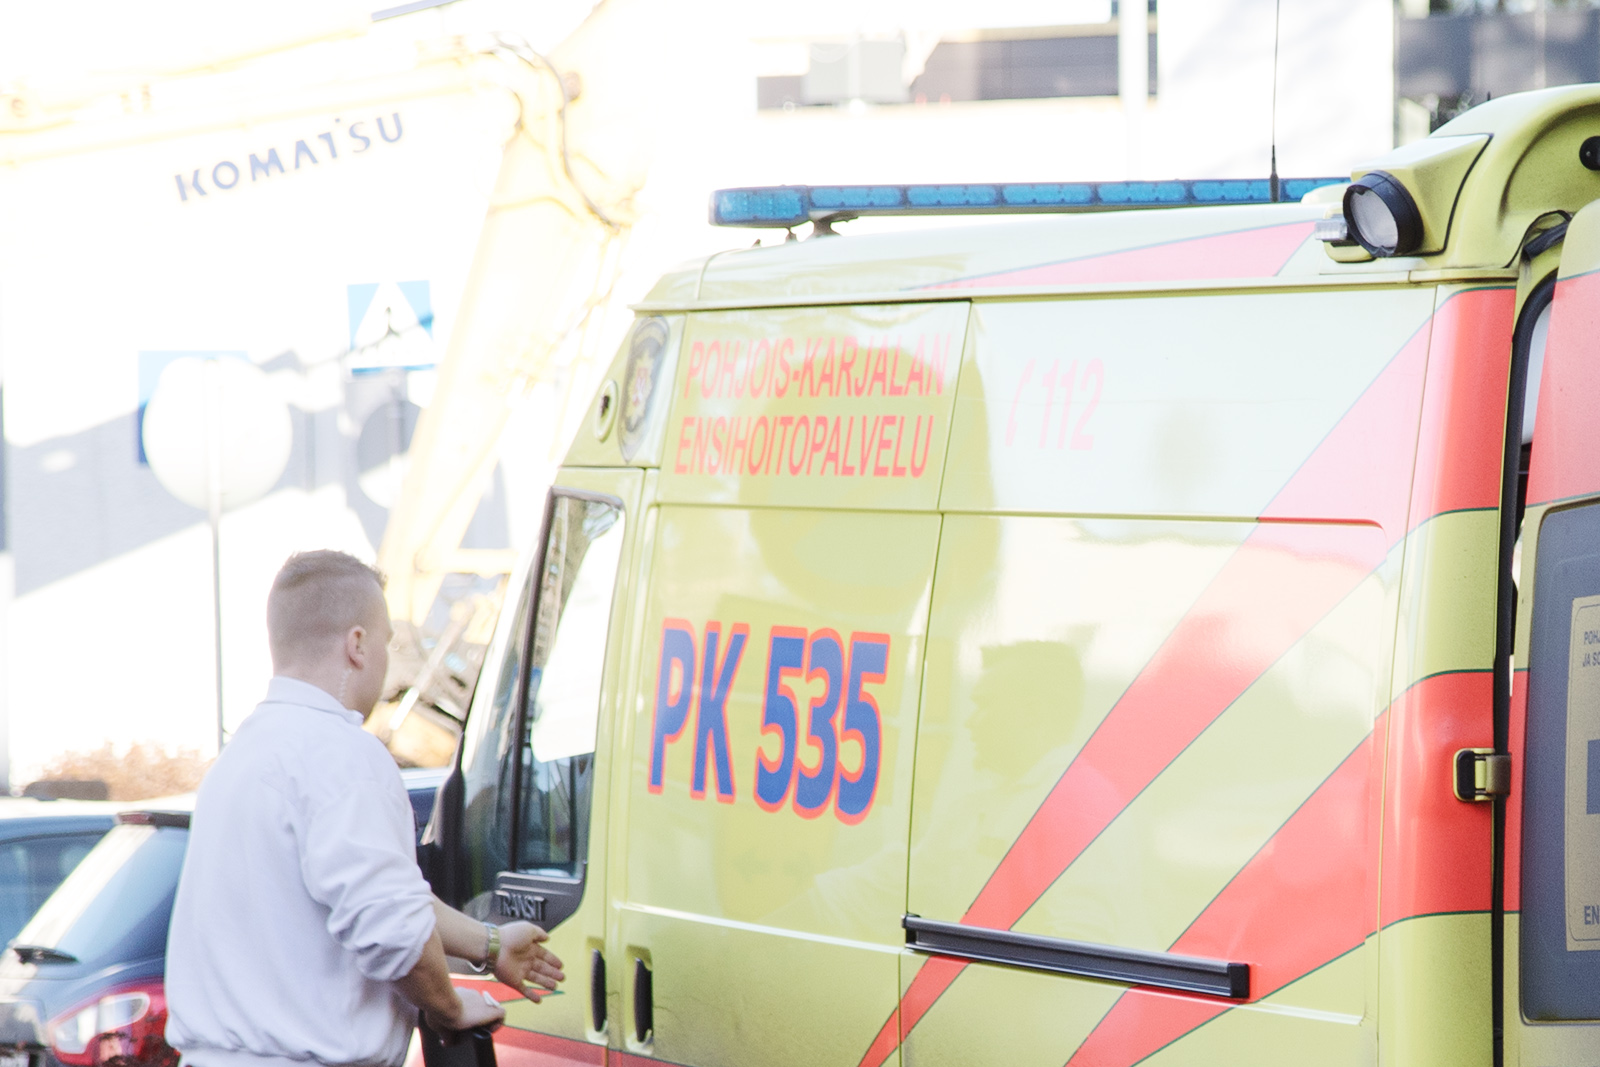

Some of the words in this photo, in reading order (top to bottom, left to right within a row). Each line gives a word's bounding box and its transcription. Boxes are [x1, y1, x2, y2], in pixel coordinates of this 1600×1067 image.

[174, 112, 404, 202] KOMATSU
[683, 335, 951, 400] POHJOIS-KARJALAN
[1038, 357, 1105, 451] 112
[674, 414, 934, 479] ENSIHOITOPALVELU
[1582, 652, 1591, 667] JA
[647, 617, 750, 806] PK
[752, 625, 891, 827] 535
